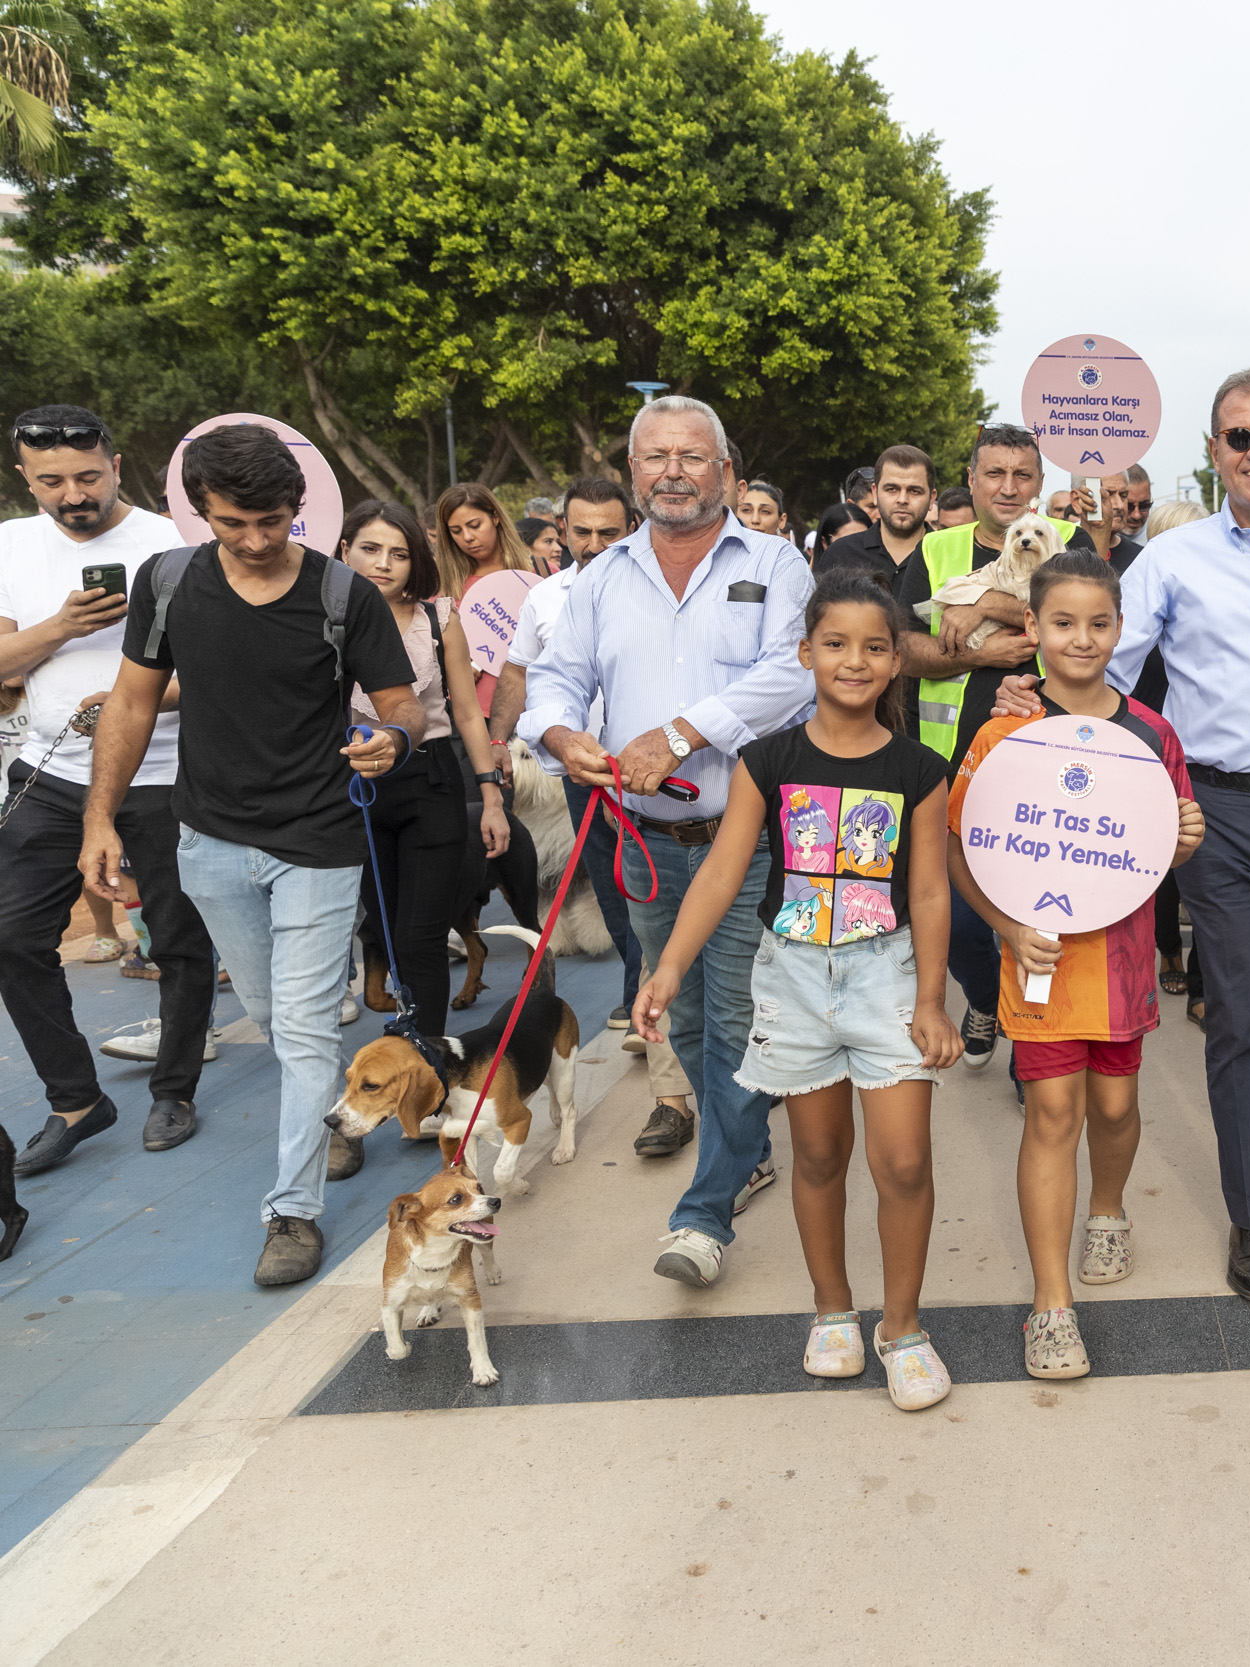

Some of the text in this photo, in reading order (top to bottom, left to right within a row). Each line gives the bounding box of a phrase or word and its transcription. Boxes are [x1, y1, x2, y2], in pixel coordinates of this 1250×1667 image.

[1042, 394, 1140, 409] Hayvanlara Karşı
[1049, 409, 1133, 424] Acımasız Olan,
[1033, 422, 1149, 439] İyi Bir İnsan Olamaz.
[470, 603, 508, 641] Şiddete
[7, 715, 28, 729] TO
[1070, 762, 1093, 775] MERSİN
[1015, 803, 1126, 838] Bir Tas Su
[968, 827, 1159, 876] Bir Kap Yemek...
[901, 1335, 922, 1345] GEZER
